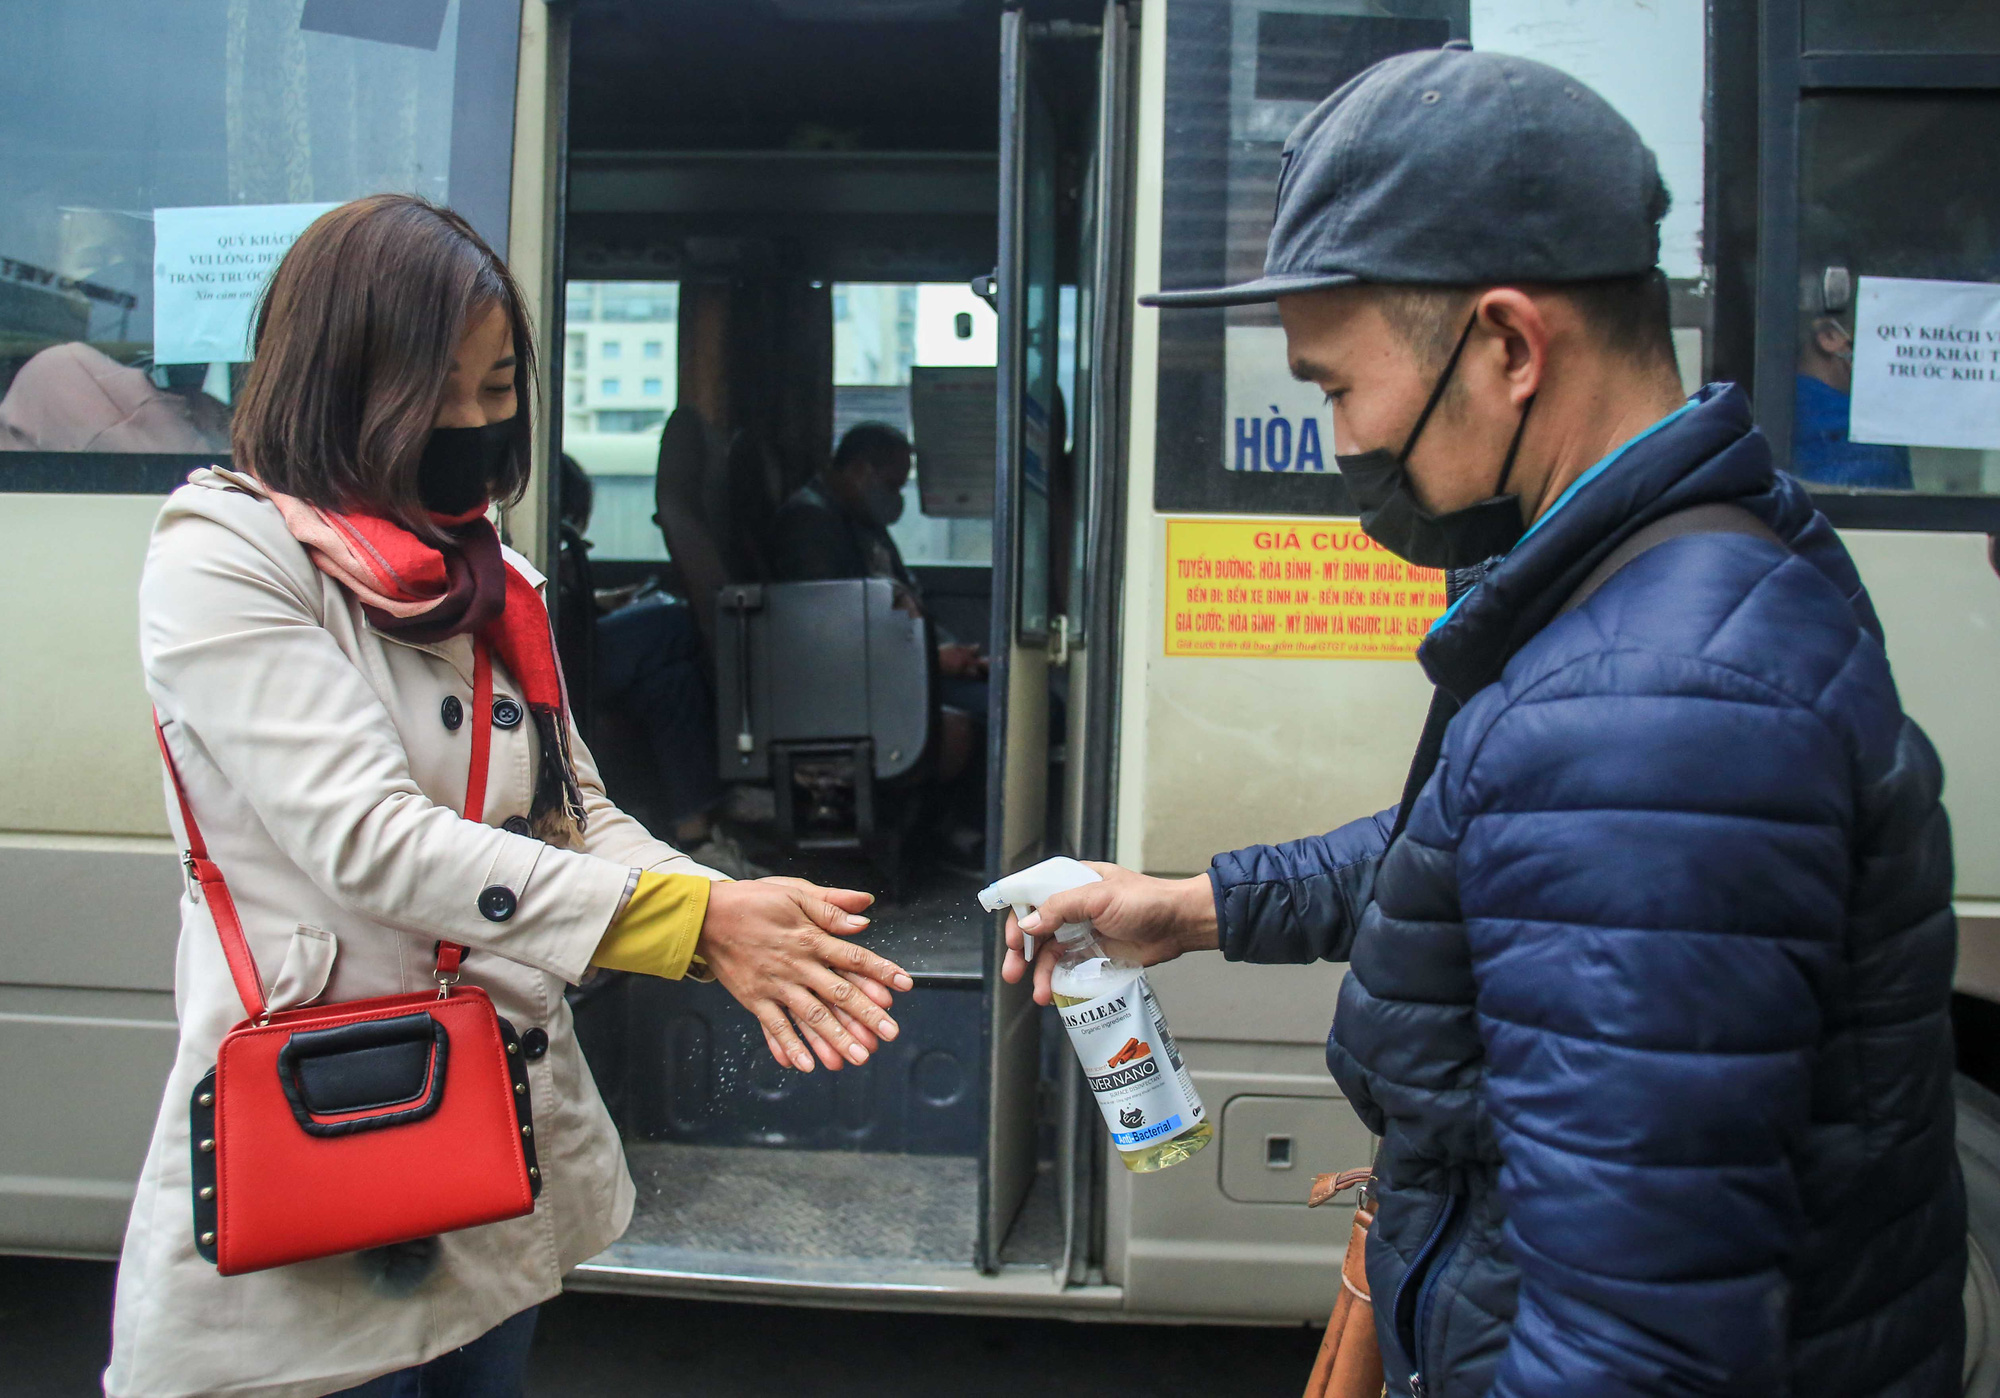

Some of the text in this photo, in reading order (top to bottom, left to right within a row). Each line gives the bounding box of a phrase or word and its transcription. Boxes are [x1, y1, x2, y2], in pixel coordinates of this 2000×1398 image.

[189, 253, 213, 266] VUI
[169, 272, 215, 285] TRANG
[1877, 322, 1913, 341] QUÝ
[1919, 323, 1982, 343] KHÁCH
[1951, 366, 1985, 381] KHI
[1234, 404, 1324, 473] HÒA
[1253, 527, 1302, 551] GIÁ
[1177, 552, 1212, 580] TUYẾN
[1260, 556, 1282, 581] HÒA
[1285, 556, 1312, 581] BÌNH
[1343, 558, 1370, 583] ĐÌNH
[1187, 582, 1207, 604] BẾN
[1227, 582, 1247, 605] BẾN
[1250, 589, 1263, 605] XE
[1266, 587, 1291, 605] BÌNH
[1295, 590, 1309, 606] AN
[1319, 586, 1340, 607] BẾN
[1369, 586, 1390, 608] BẾN
[1394, 592, 1406, 608] XE
[1429, 590, 1447, 608] ĐÌN
[1176, 608, 1192, 633] GIÁ
[1228, 609, 1248, 634] HÒA
[1251, 610, 1276, 634] BÌNH
[1304, 611, 1328, 635] ĐÌNH
[1331, 611, 1344, 635] VÀ
[1081, 1012, 1132, 1035] Organic ingredients
[1112, 1061, 1155, 1087] NANO
[1128, 1073, 1163, 1093] DISINFECTANT
[1118, 1119, 1173, 1145] Anti-Bacterial
